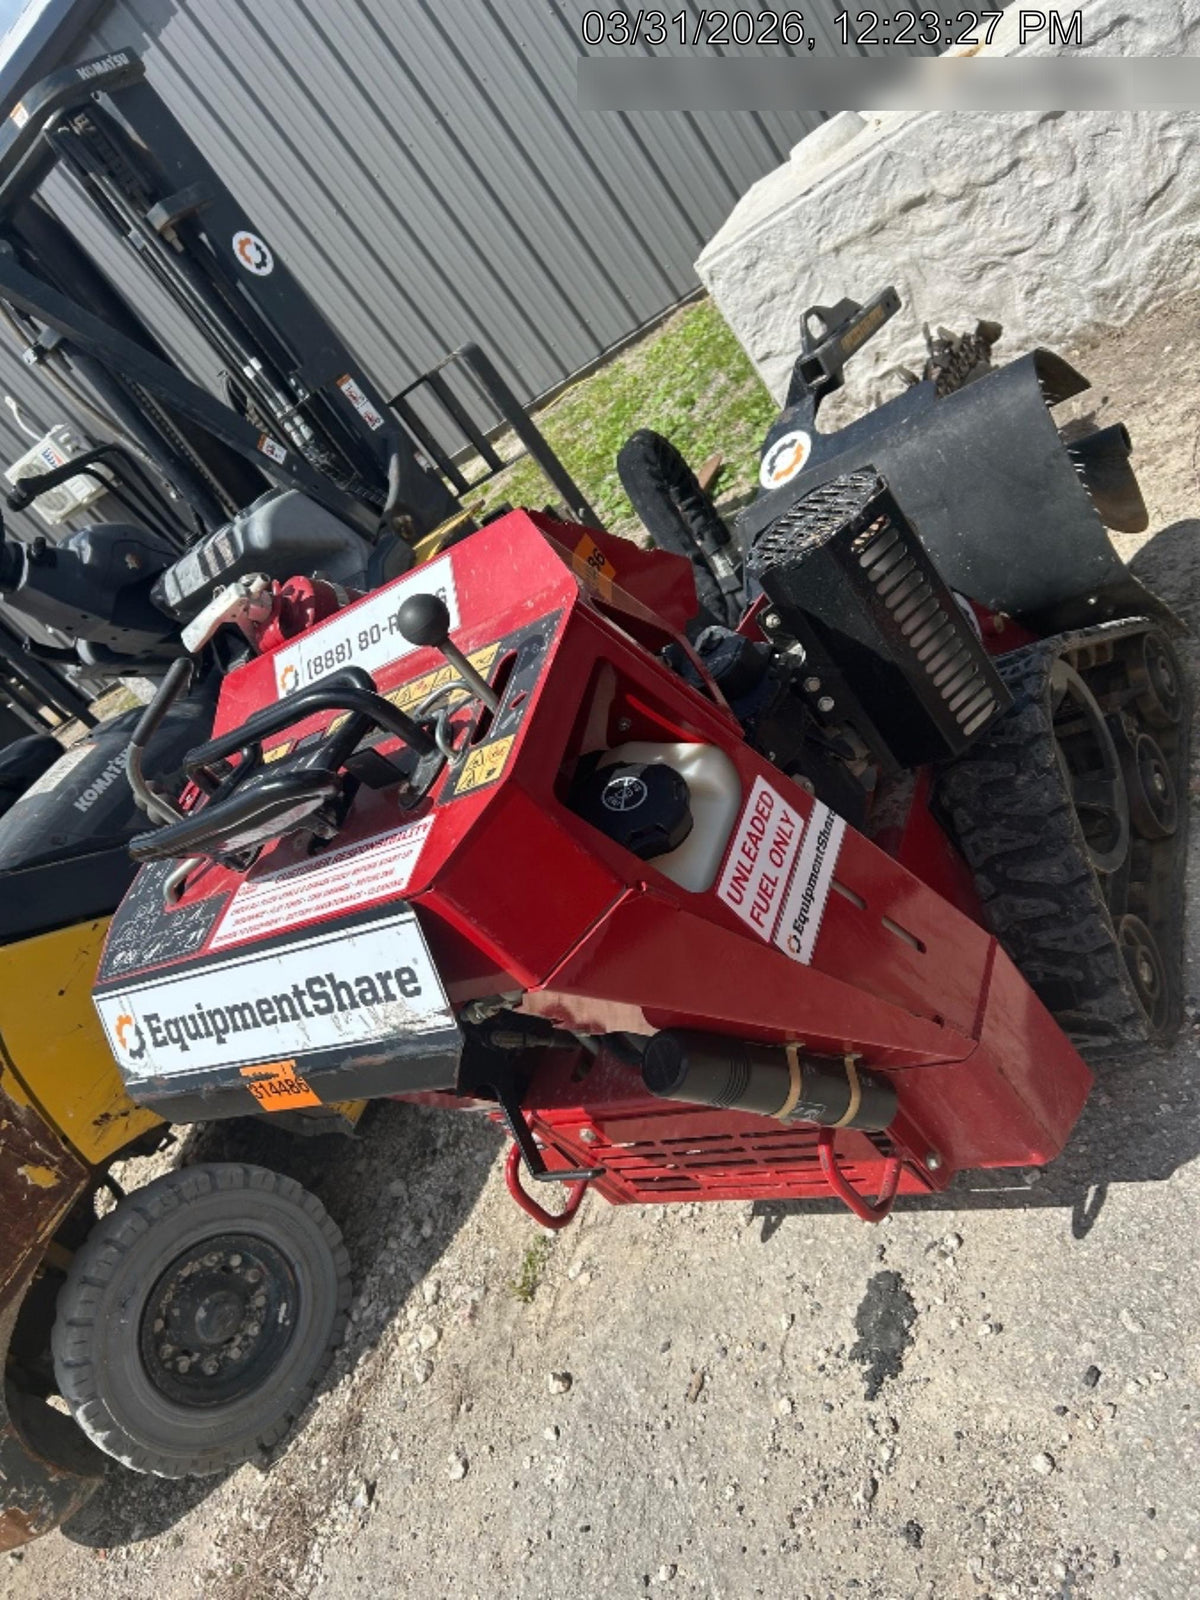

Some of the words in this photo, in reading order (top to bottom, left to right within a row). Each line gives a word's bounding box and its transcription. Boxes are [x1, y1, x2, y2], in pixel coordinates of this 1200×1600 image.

[76, 53, 130, 80] KOMATSU
[306, 638, 353, 680] (888)
[726, 790, 775, 906] UNLEADED
[750, 872, 779, 928] FUEL
[768, 810, 796, 868] ONLY
[143, 964, 422, 1052] EquipmentShare
[248, 1077, 310, 1099] 314486
